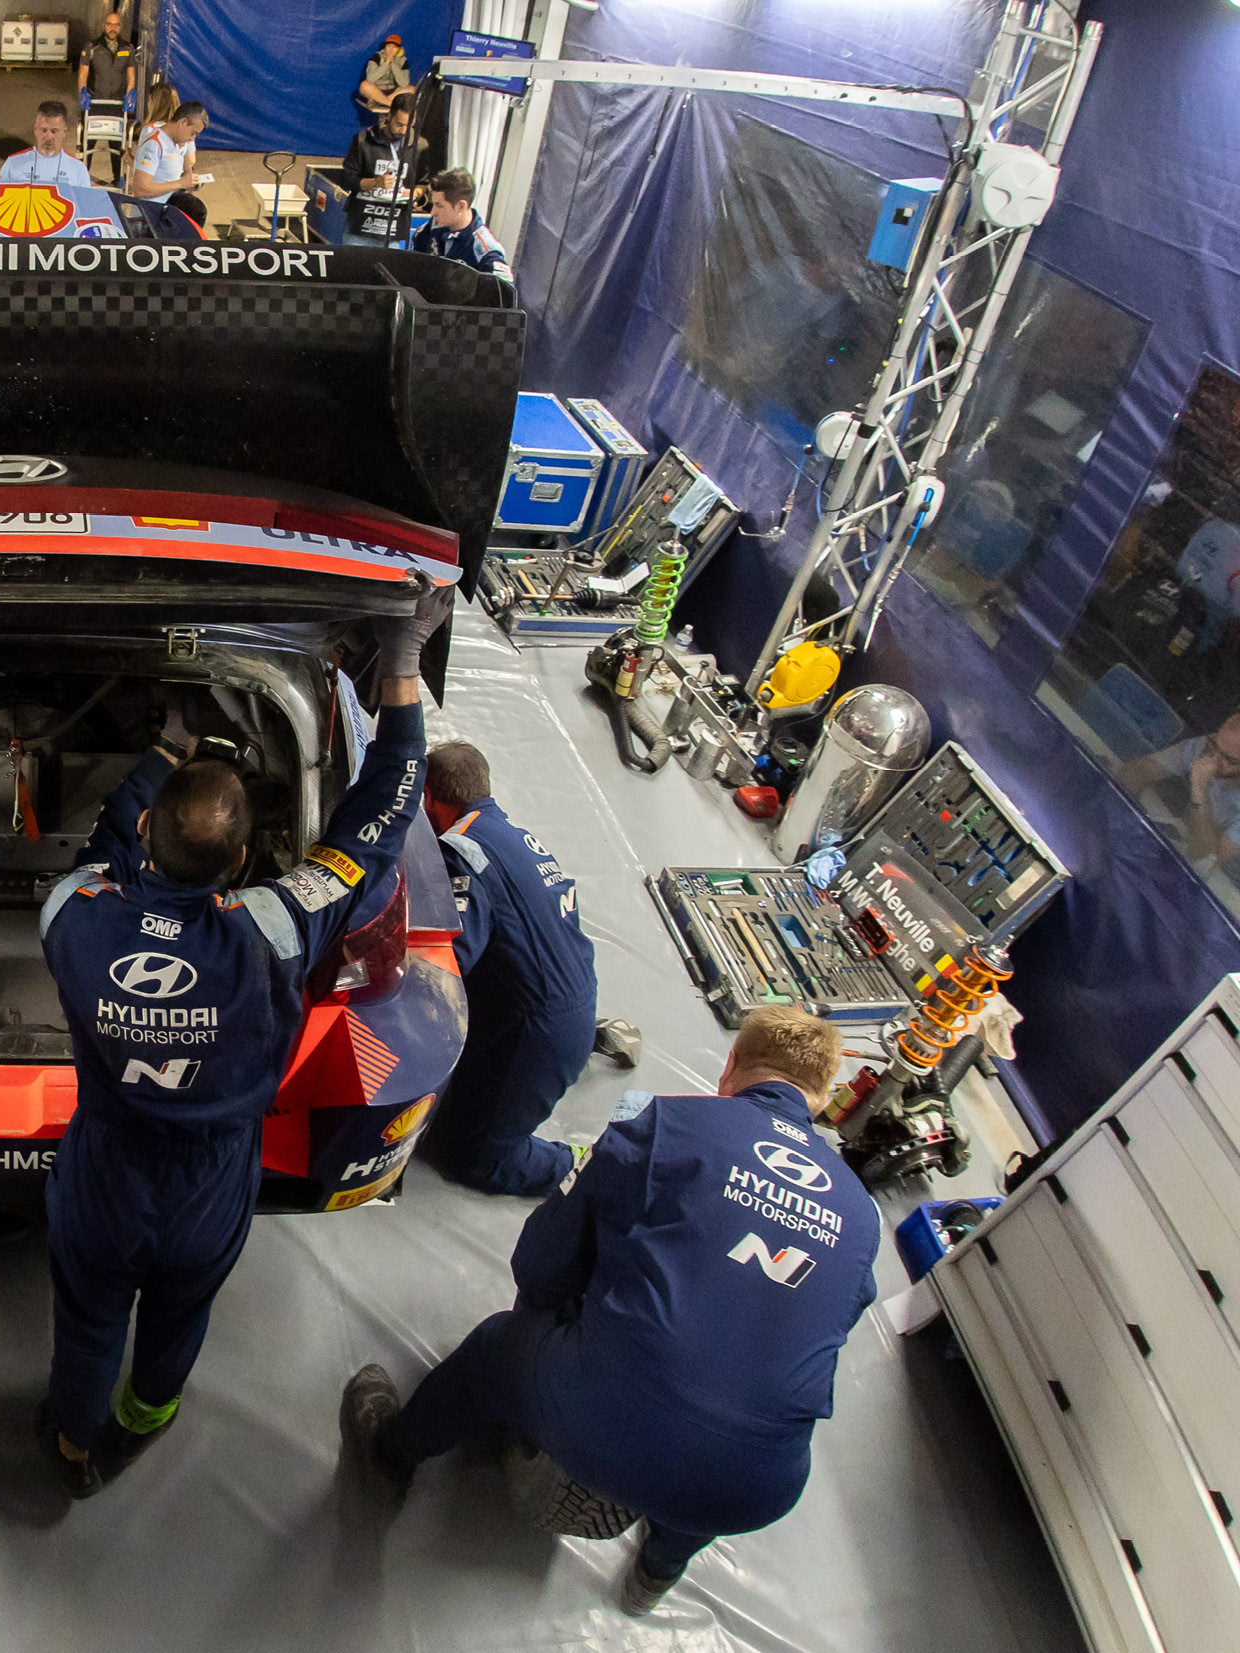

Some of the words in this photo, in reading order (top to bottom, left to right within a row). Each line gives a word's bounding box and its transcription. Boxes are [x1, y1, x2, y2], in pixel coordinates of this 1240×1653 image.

[465, 34, 489, 46] Thierry
[489, 39, 517, 50] Neuville
[28, 243, 334, 278] MOTORSPORT
[865, 861, 885, 885] T.
[876, 879, 935, 953] Neuville
[141, 915, 183, 938] OMP
[97, 998, 218, 1028] HYUNDAI
[96, 1020, 219, 1045] MOTORSPORT
[772, 1120, 809, 1142] OMP
[728, 1165, 843, 1235] HYUNDAI
[723, 1184, 841, 1249] MOTORSPORT
